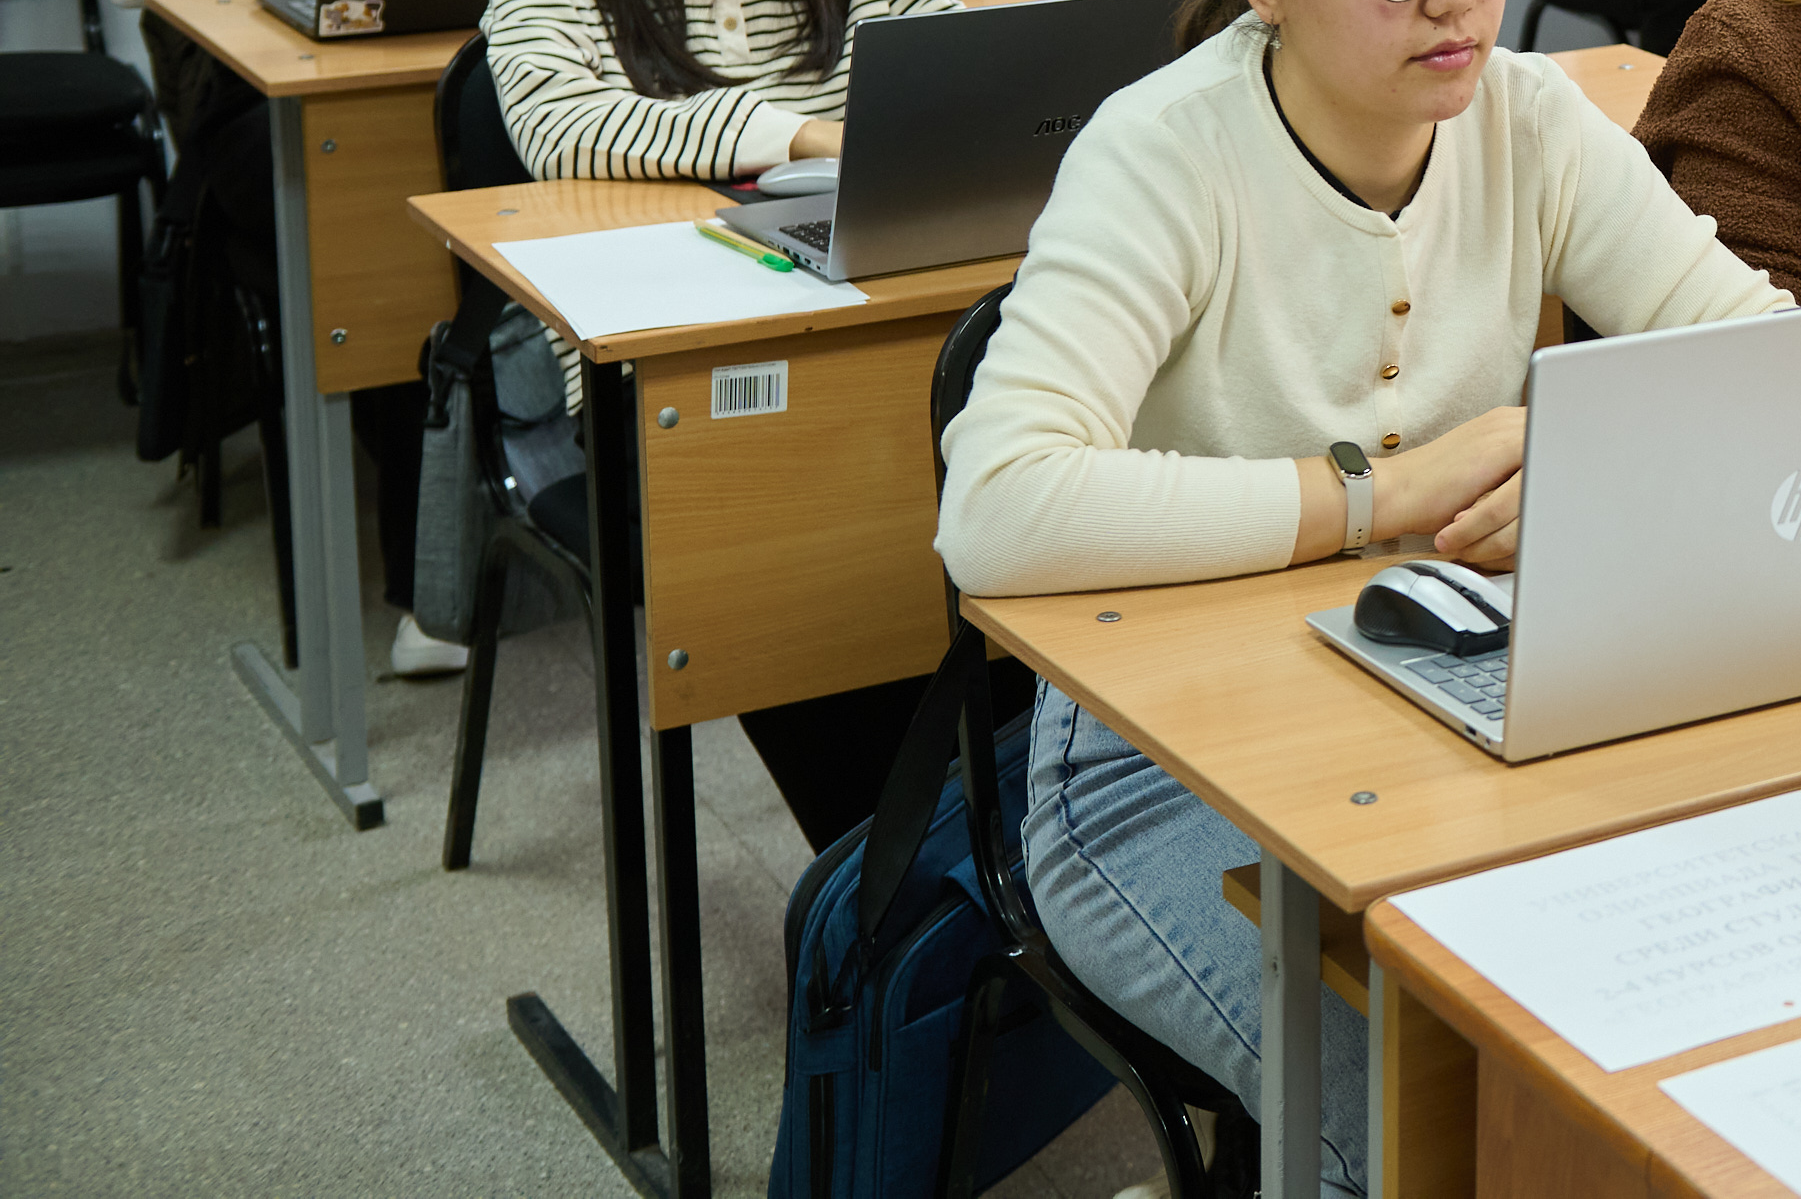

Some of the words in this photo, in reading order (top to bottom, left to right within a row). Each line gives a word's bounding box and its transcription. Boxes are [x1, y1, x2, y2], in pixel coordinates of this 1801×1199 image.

[1578, 862, 1782, 923] ОЛИМПИАДА
[1614, 928, 1721, 966] СРЕДИ
[1644, 941, 1776, 988] КУРСОВ
